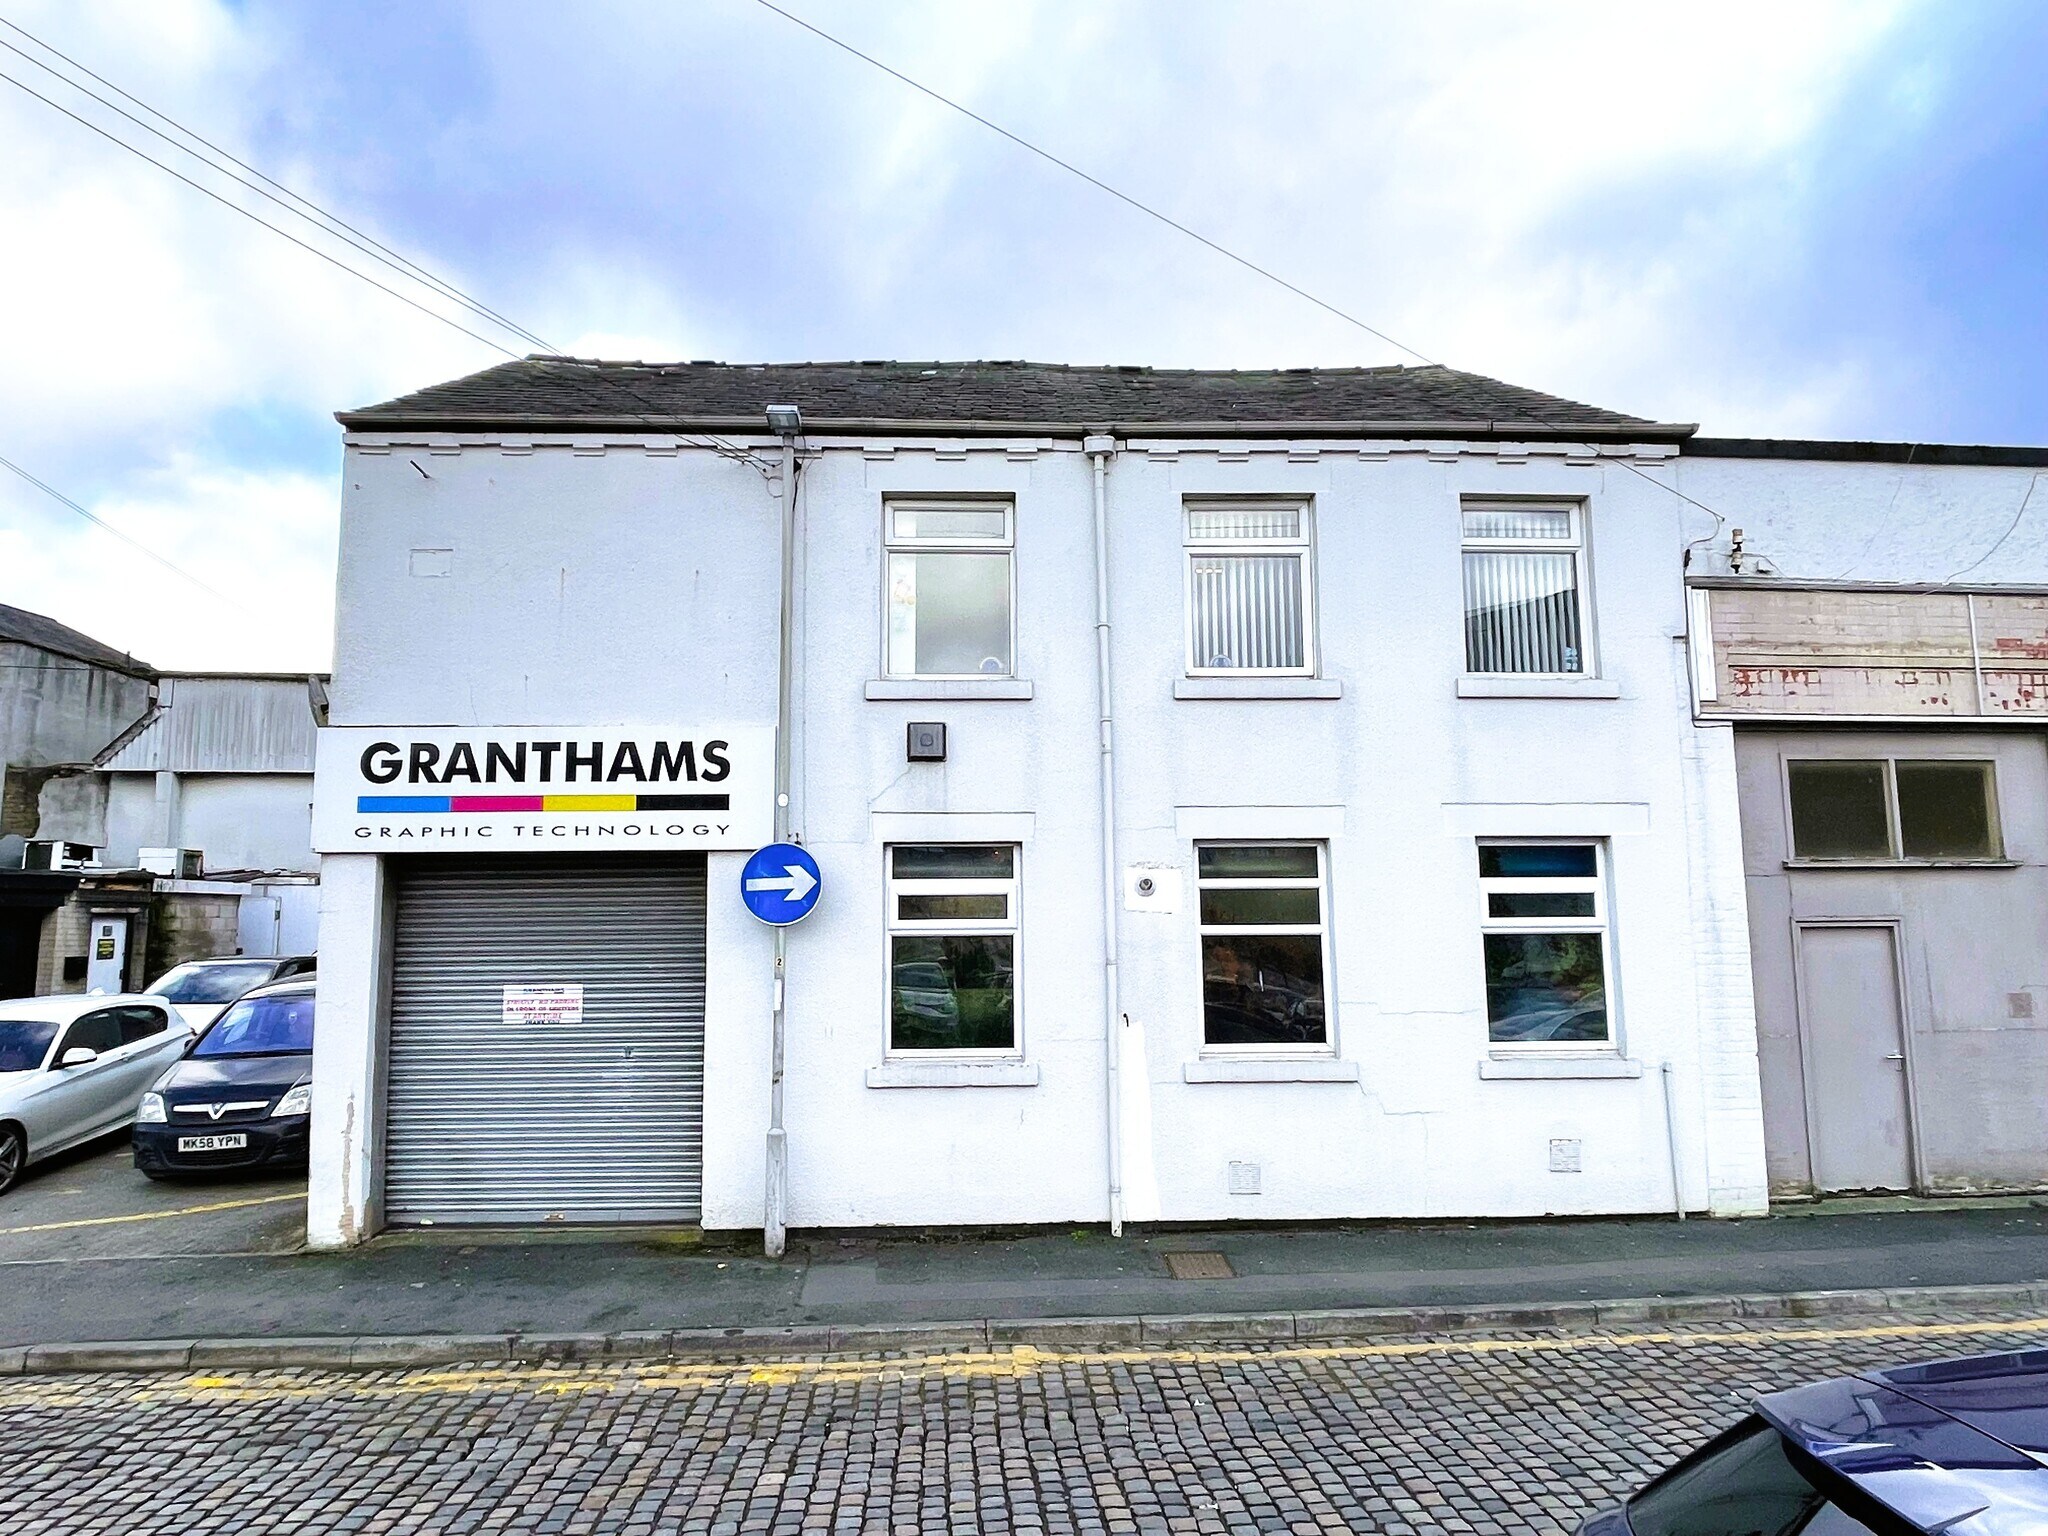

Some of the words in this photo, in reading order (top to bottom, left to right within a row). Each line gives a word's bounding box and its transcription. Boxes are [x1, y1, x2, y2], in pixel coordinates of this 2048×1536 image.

[360, 740, 731, 784] GRANTHAMS
[354, 826, 493, 838] GRAPHIC
[513, 824, 731, 837] TECHNOLOGY
[182, 1137, 214, 1149] MK58
[217, 1135, 241, 1147] YPN
